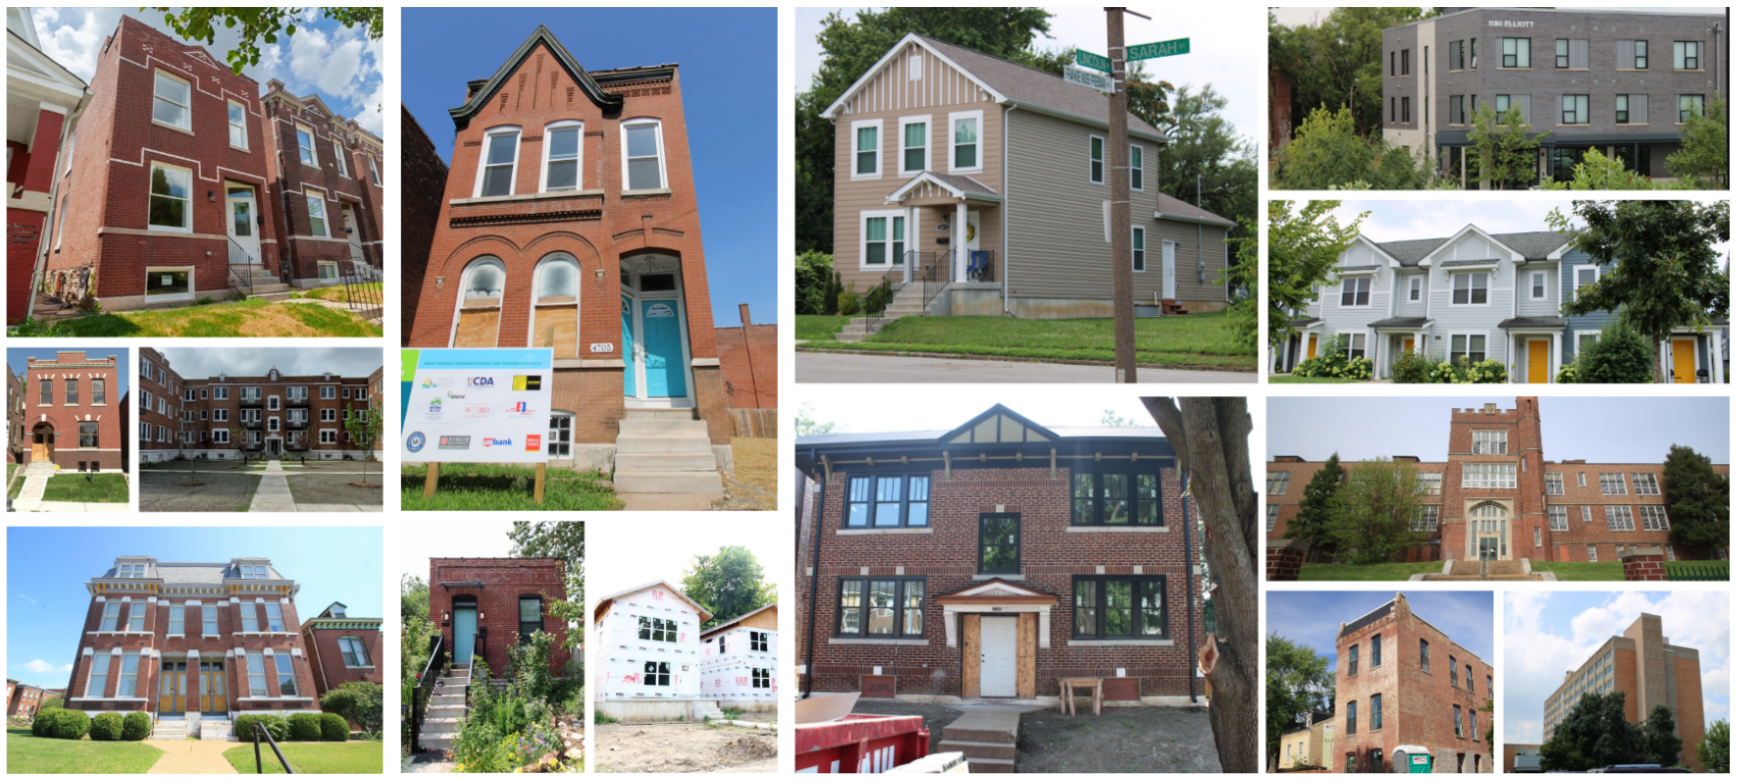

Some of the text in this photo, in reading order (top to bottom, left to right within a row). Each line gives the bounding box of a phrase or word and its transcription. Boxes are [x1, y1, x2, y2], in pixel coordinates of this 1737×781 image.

[1504, 20, 1535, 28] ELLIOTT
[1130, 42, 1177, 59] SARAH
[1079, 52, 1106, 70] LINCOLN
[592, 344, 612, 352] 4705
[867, 683, 889, 692] ZIP
